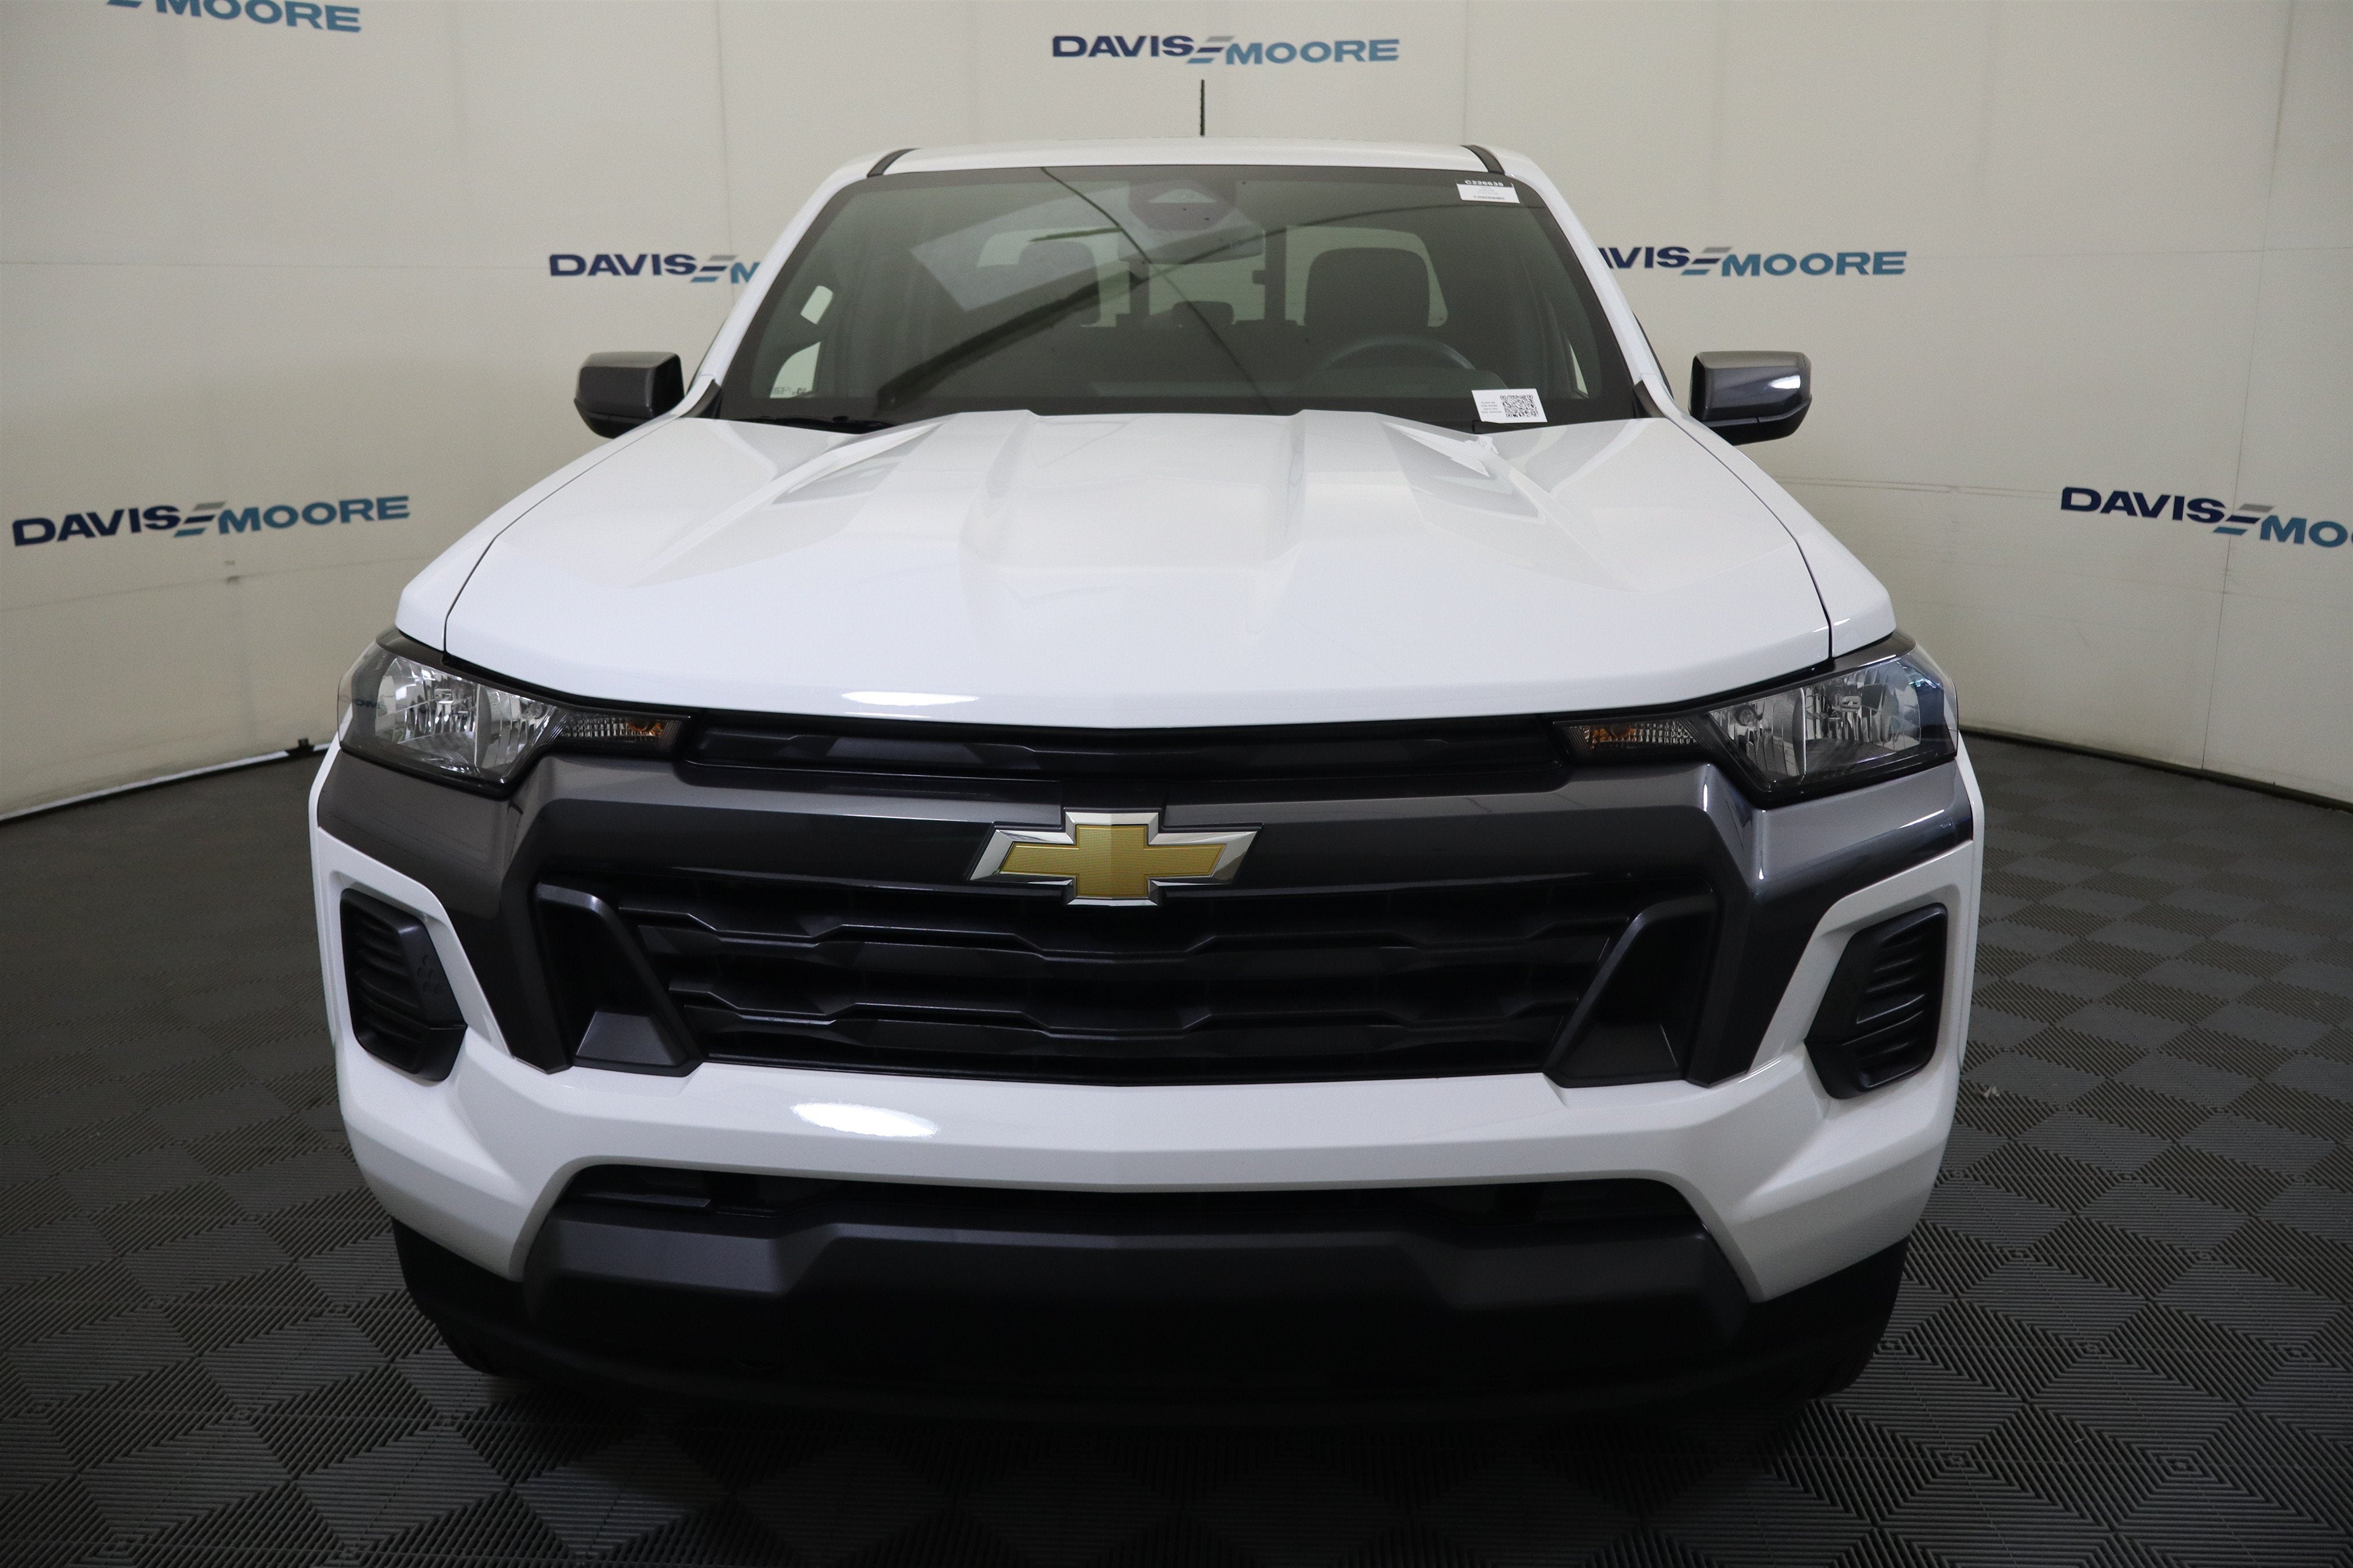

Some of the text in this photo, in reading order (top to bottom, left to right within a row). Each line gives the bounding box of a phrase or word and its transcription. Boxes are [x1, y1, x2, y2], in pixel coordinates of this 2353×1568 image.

[1052, 35, 1400, 65] DAVIS MOORE
[549, 253, 697, 276] DAVIS
[1598, 246, 1907, 277] VIS MOORE
[2061, 486, 2226, 524] DAVIS
[12, 496, 410, 546] DAVIS MOORE
